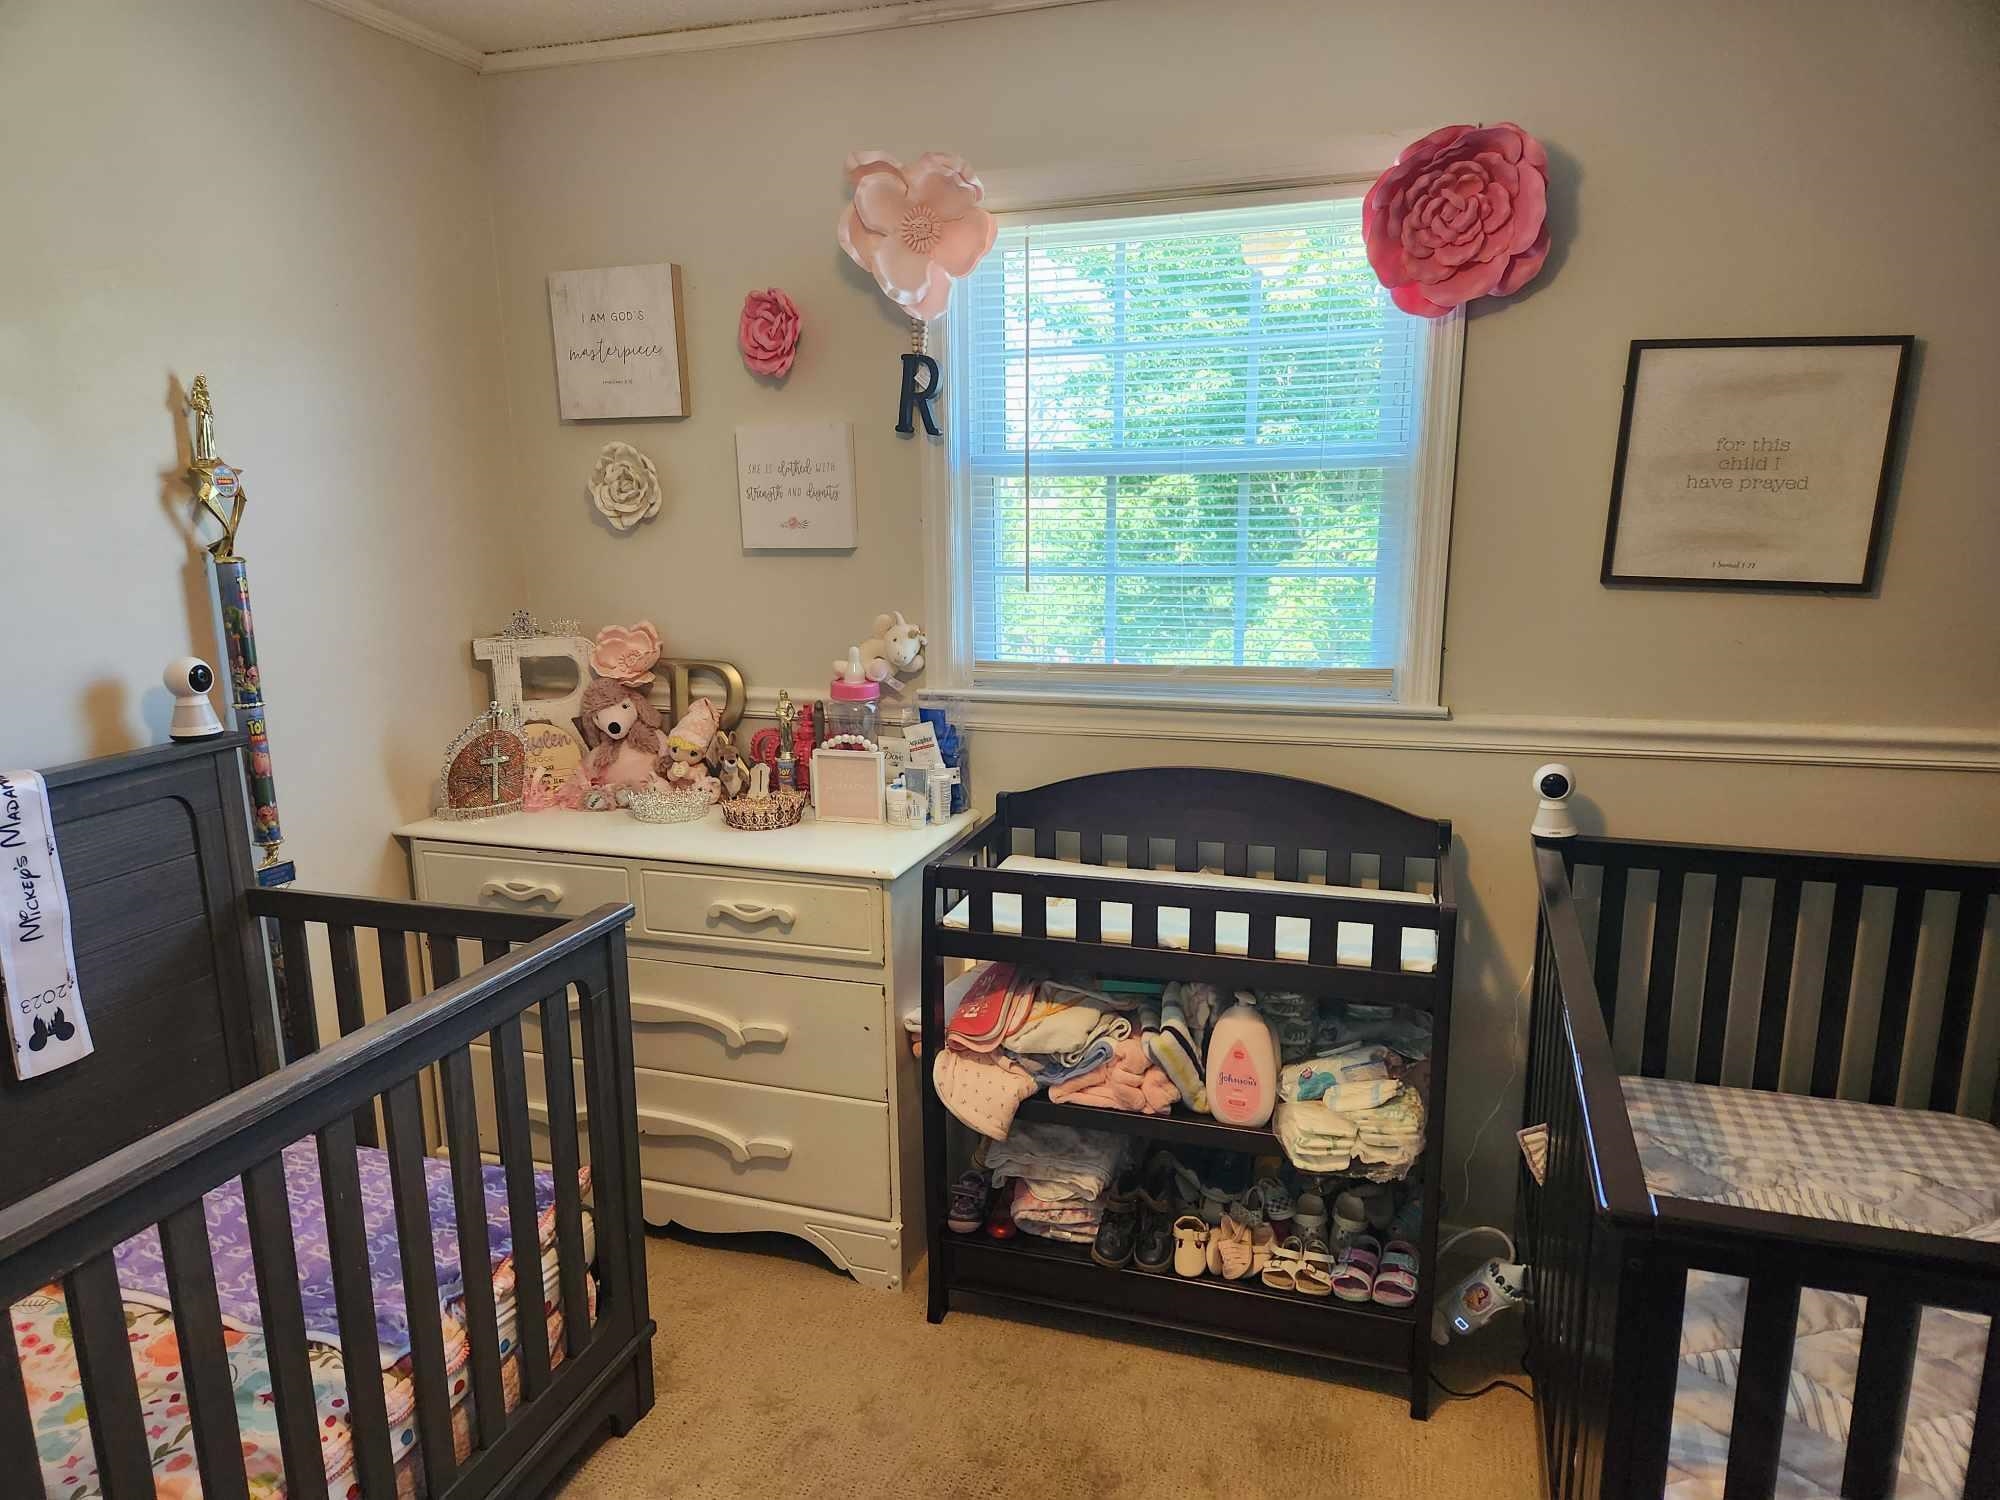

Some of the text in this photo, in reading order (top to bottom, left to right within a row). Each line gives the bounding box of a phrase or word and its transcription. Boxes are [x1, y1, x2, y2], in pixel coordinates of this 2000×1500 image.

[590, 312, 606, 323] AM
[611, 310, 645, 321] GOD'S
[569, 338, 664, 365] masterpiece
[895, 354, 943, 435] R
[1716, 437, 1791, 452] for this
[778, 458, 812, 477] clothed
[1719, 456, 1768, 471] child
[746, 482, 840, 502] strength AND dignity
[1686, 475, 1809, 493] have prayed
[884, 750, 904, 761] Dove
[21, 983, 68, 1014] 2023
[1218, 1072, 1257, 1087] Johnson's
